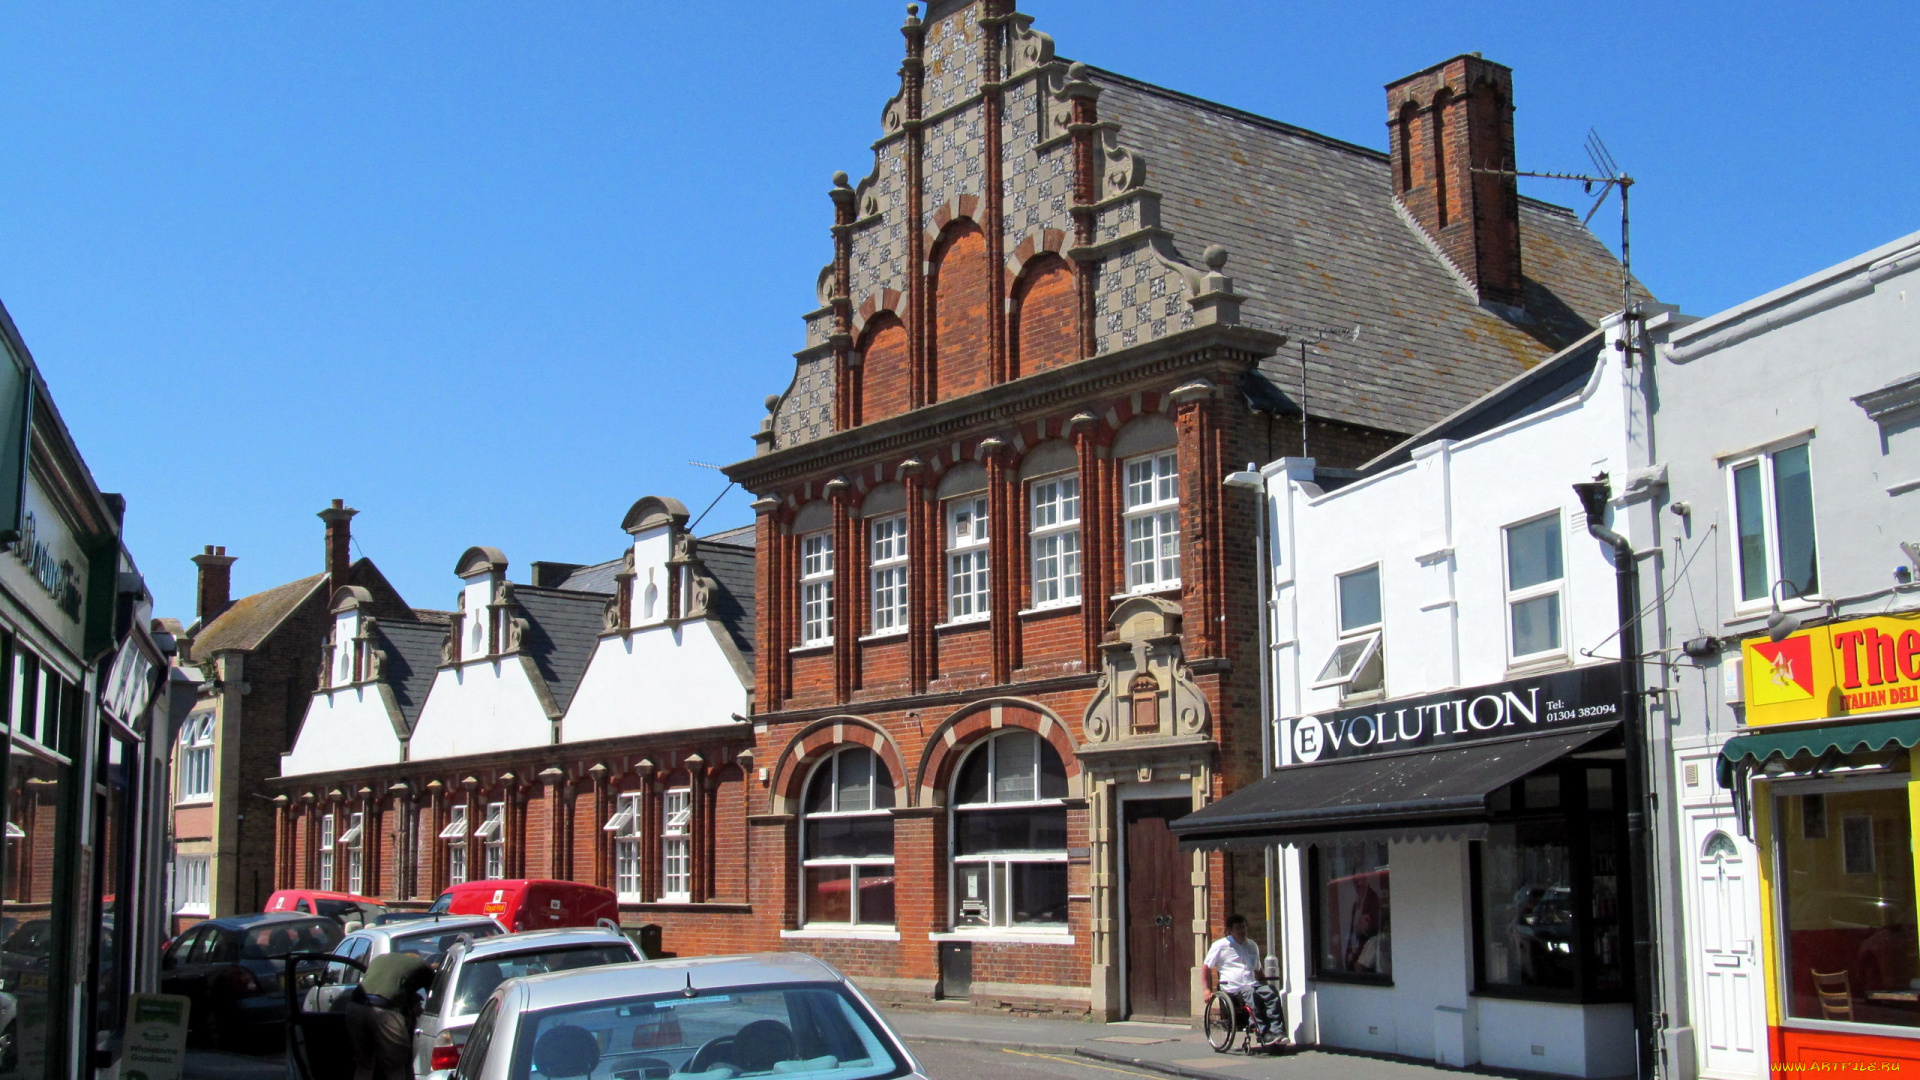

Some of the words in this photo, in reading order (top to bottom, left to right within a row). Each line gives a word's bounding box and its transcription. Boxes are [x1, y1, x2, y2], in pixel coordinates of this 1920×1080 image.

[1546, 700, 1565, 711] Tel:
[1839, 689, 1887, 711] ITALIAN
[1889, 685, 1919, 705] DELI
[1298, 687, 1540, 752] EVOLUTION
[1546, 710, 1576, 723] 01304
[1577, 703, 1617, 718] 382094
[130, 1044, 178, 1055] Wholesome
